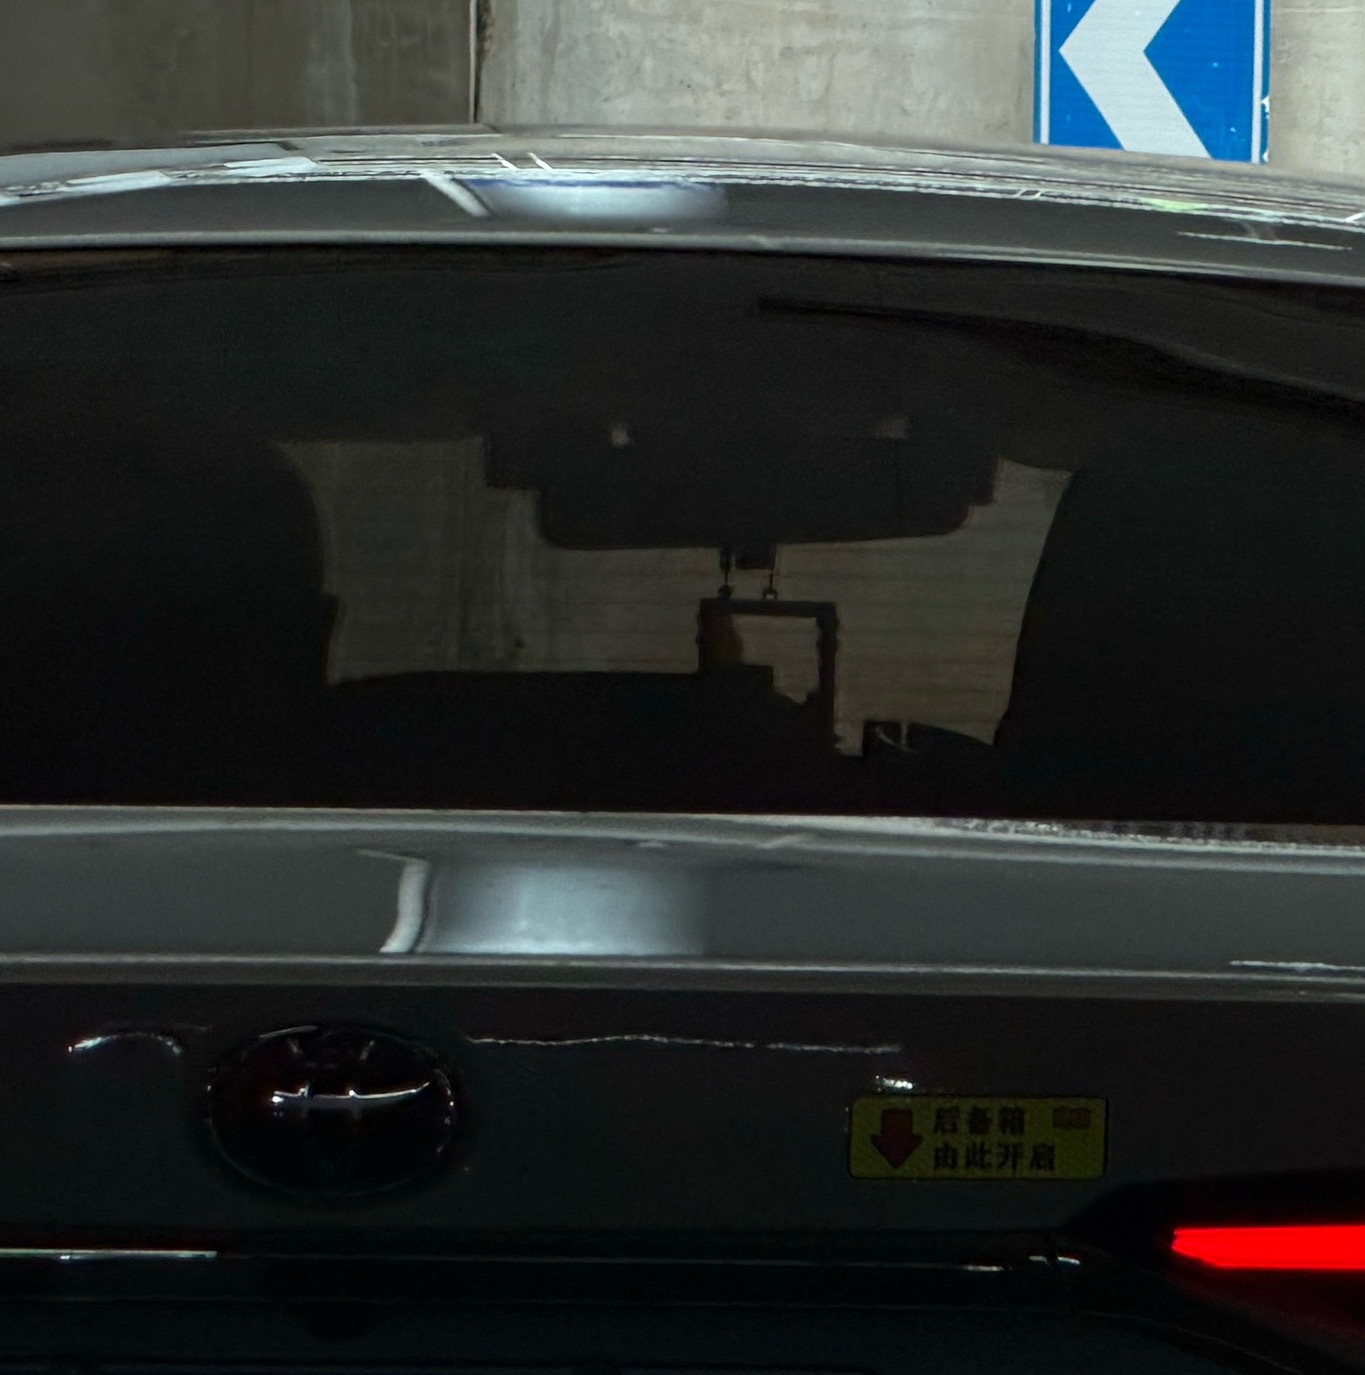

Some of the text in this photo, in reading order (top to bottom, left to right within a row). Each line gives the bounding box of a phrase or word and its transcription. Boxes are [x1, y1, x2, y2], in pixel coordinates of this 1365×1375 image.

[933, 1105, 1026, 1135] 后备箱
[933, 1141, 1057, 1171] 由此开启
